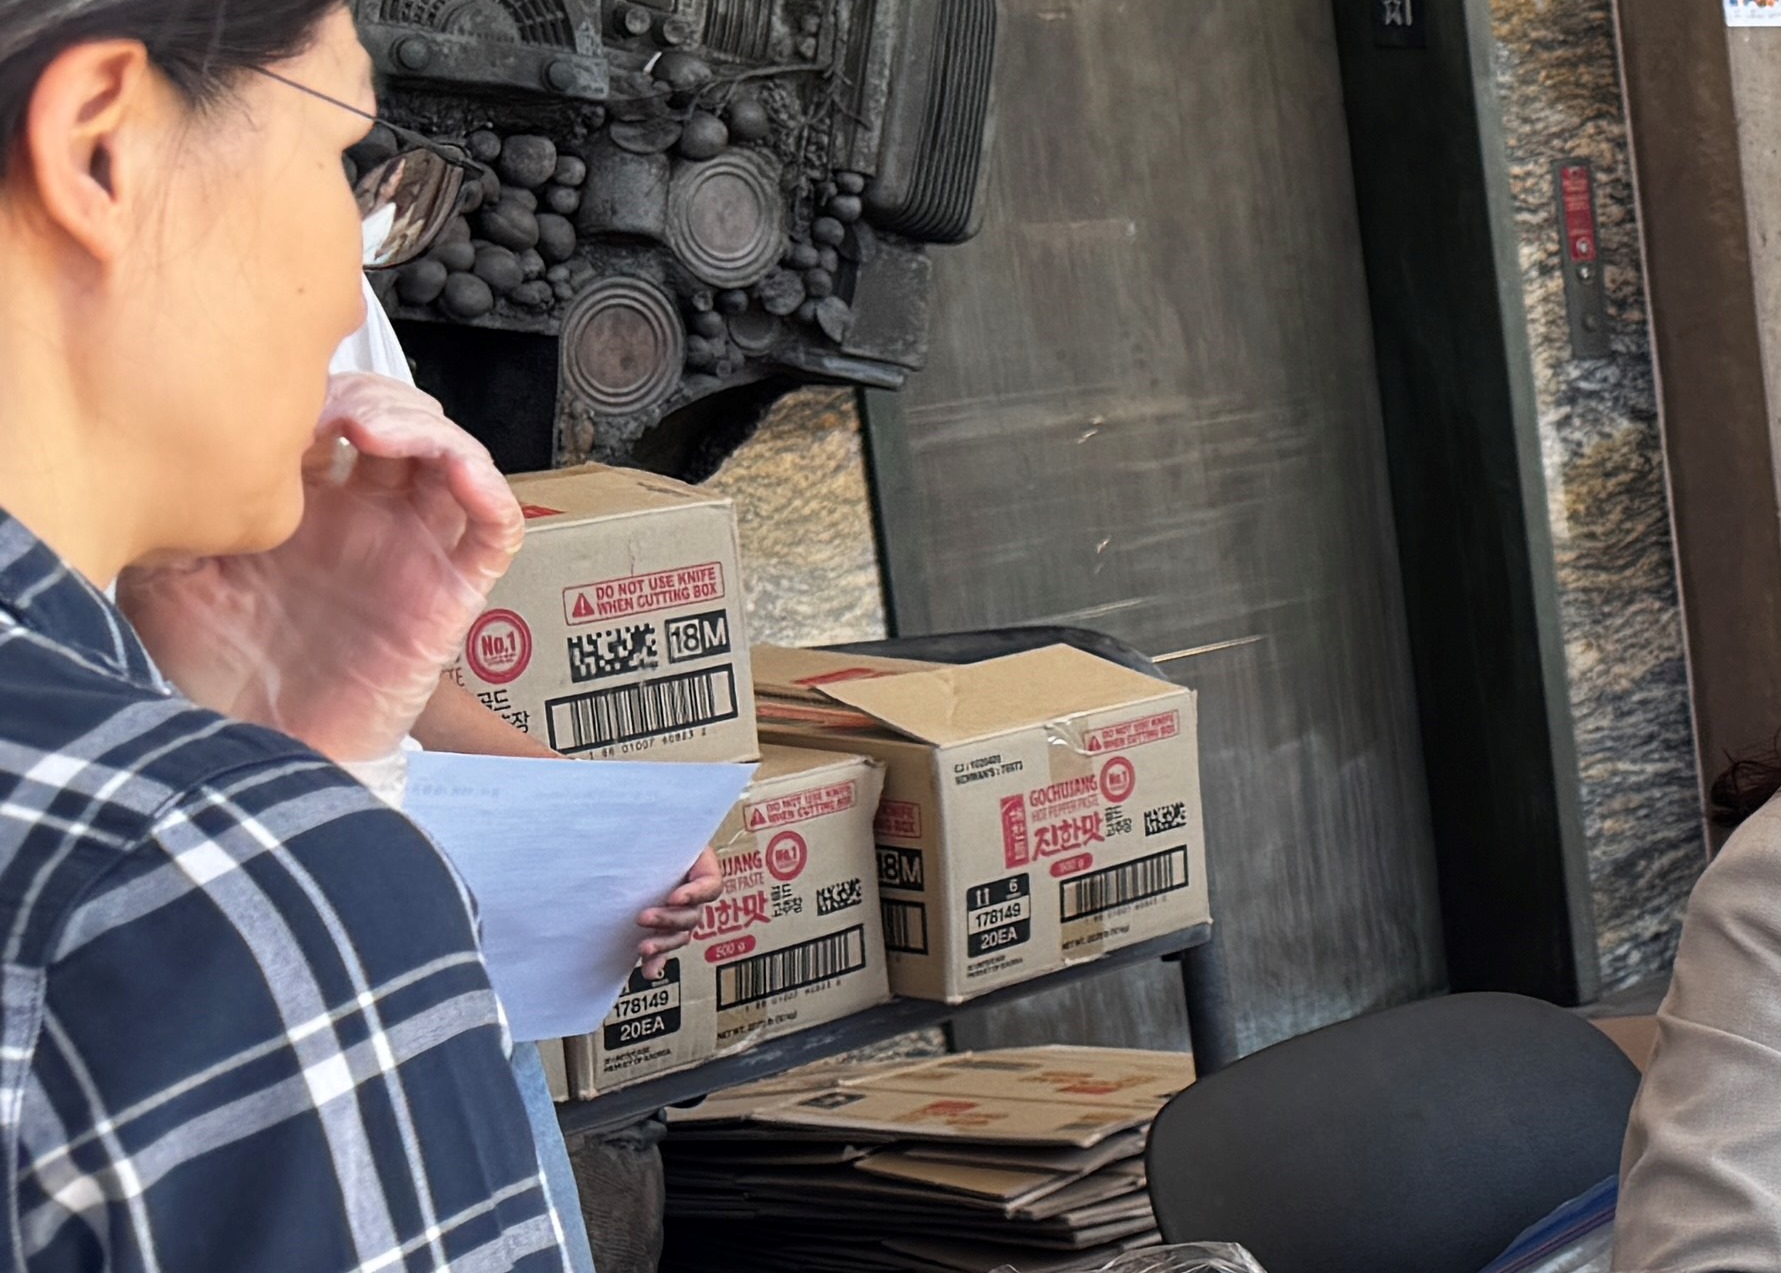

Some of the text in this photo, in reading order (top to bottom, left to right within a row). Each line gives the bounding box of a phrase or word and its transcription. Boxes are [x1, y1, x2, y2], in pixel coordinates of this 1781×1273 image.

[596, 566, 717, 601] DO NOT USE KNIFE
[597, 581, 718, 616] WHEN CUTTING BOX
[481, 630, 516, 658] No.1
[1029, 774, 1098, 807] GOCHUJANG
[1031, 811, 1105, 862] 진한맛
[975, 902, 1021, 928] 178149
[980, 926, 1018, 950] 20EA
[614, 989, 670, 1019] 178149
[619, 1016, 666, 1041] 20EA
